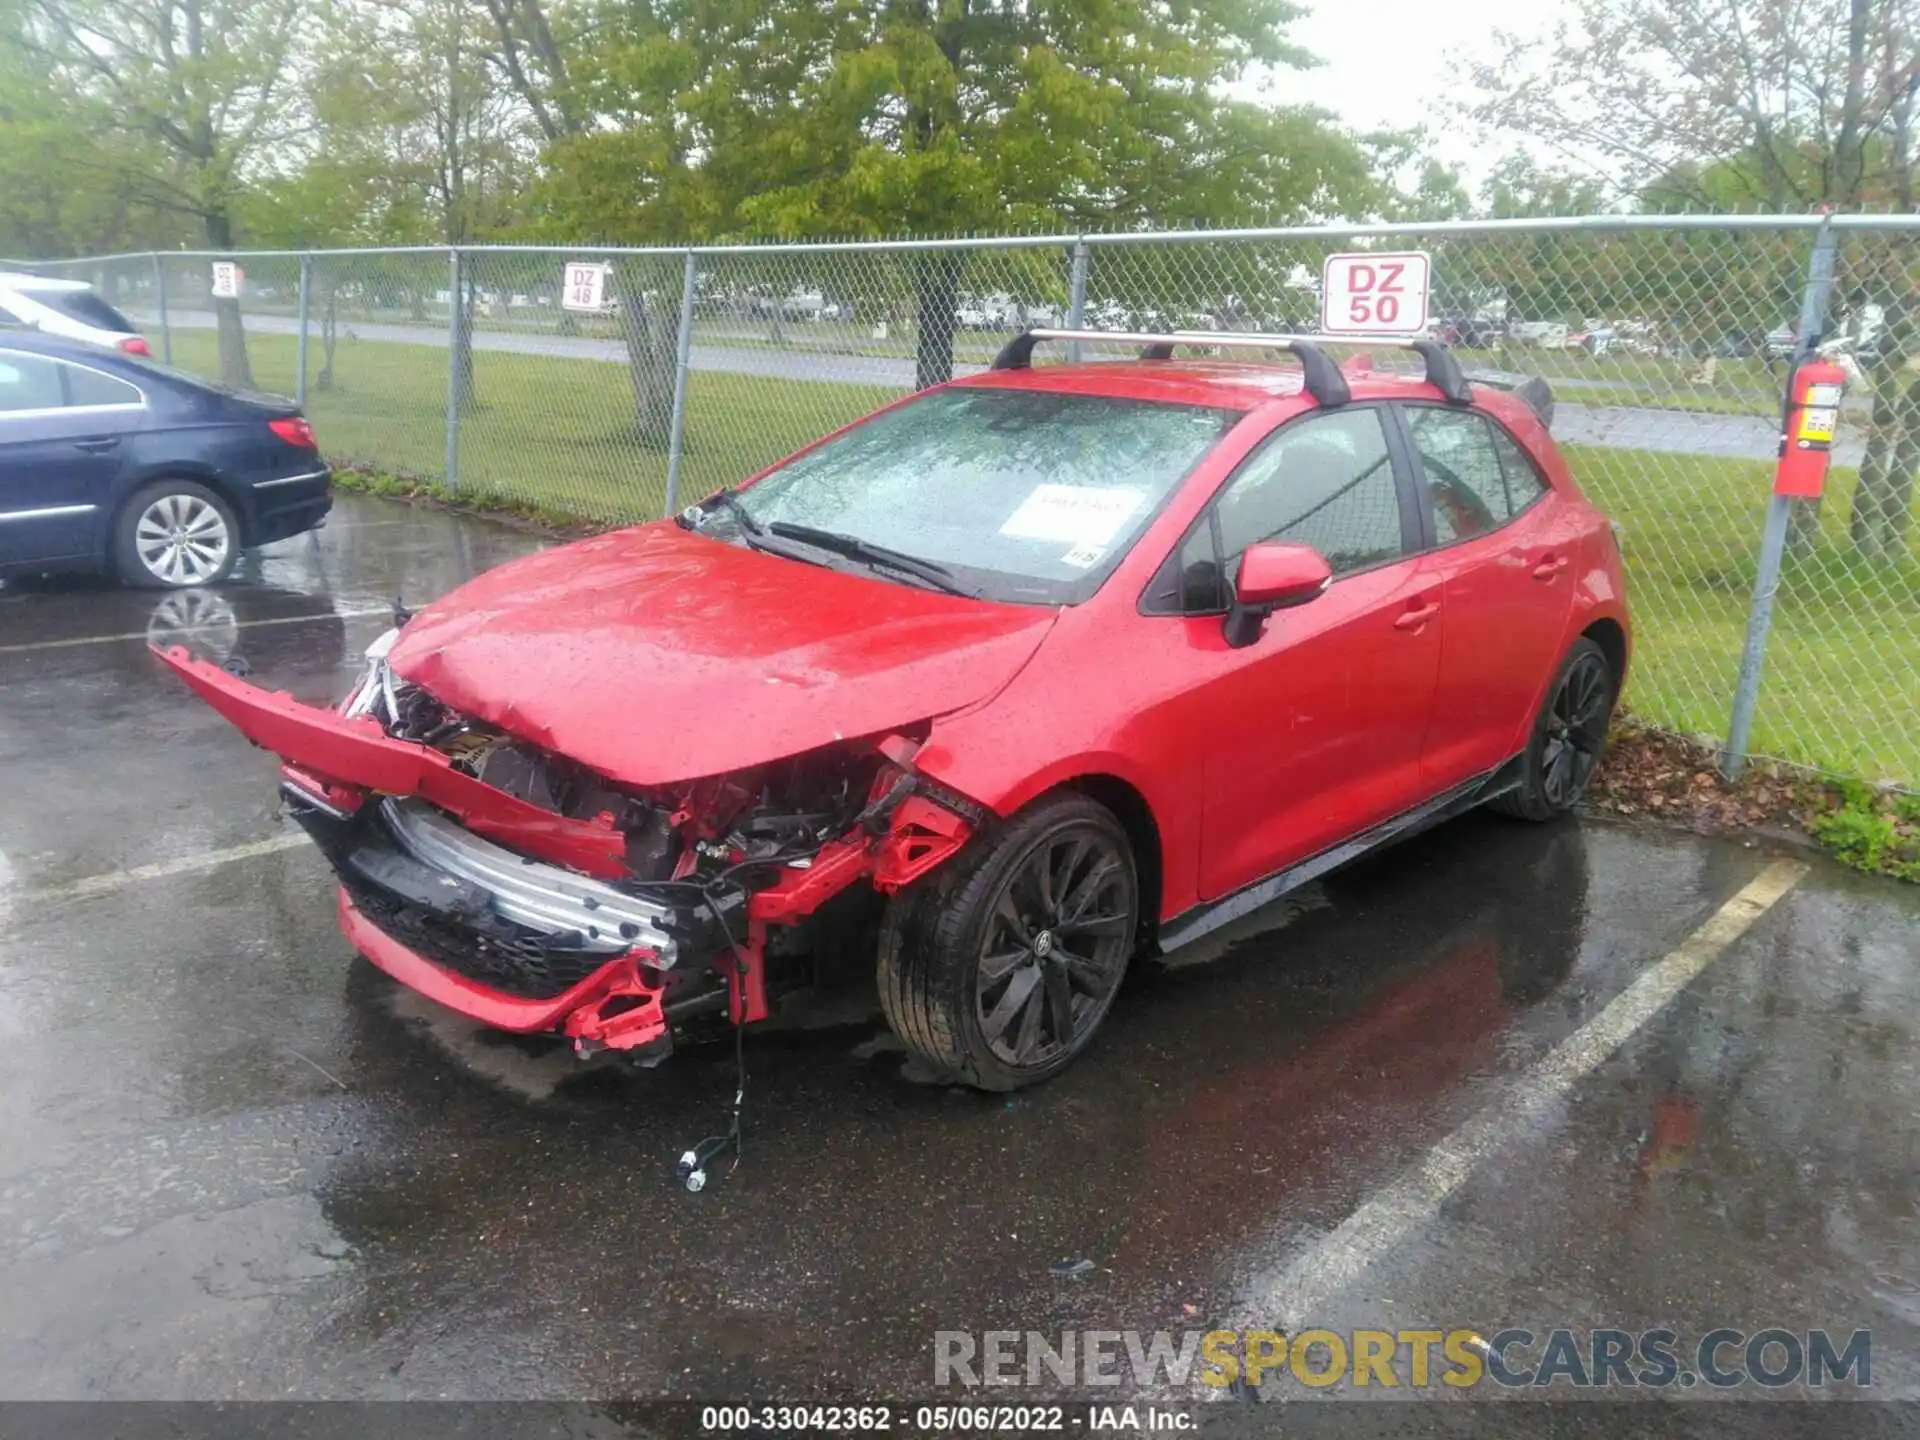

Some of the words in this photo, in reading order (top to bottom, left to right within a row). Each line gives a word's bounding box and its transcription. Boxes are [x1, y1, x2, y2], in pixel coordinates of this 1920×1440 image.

[574, 269, 596, 287] DZ
[1348, 264, 1405, 293] DZ
[572, 287, 591, 304] 48
[1349, 295, 1399, 324] 50
